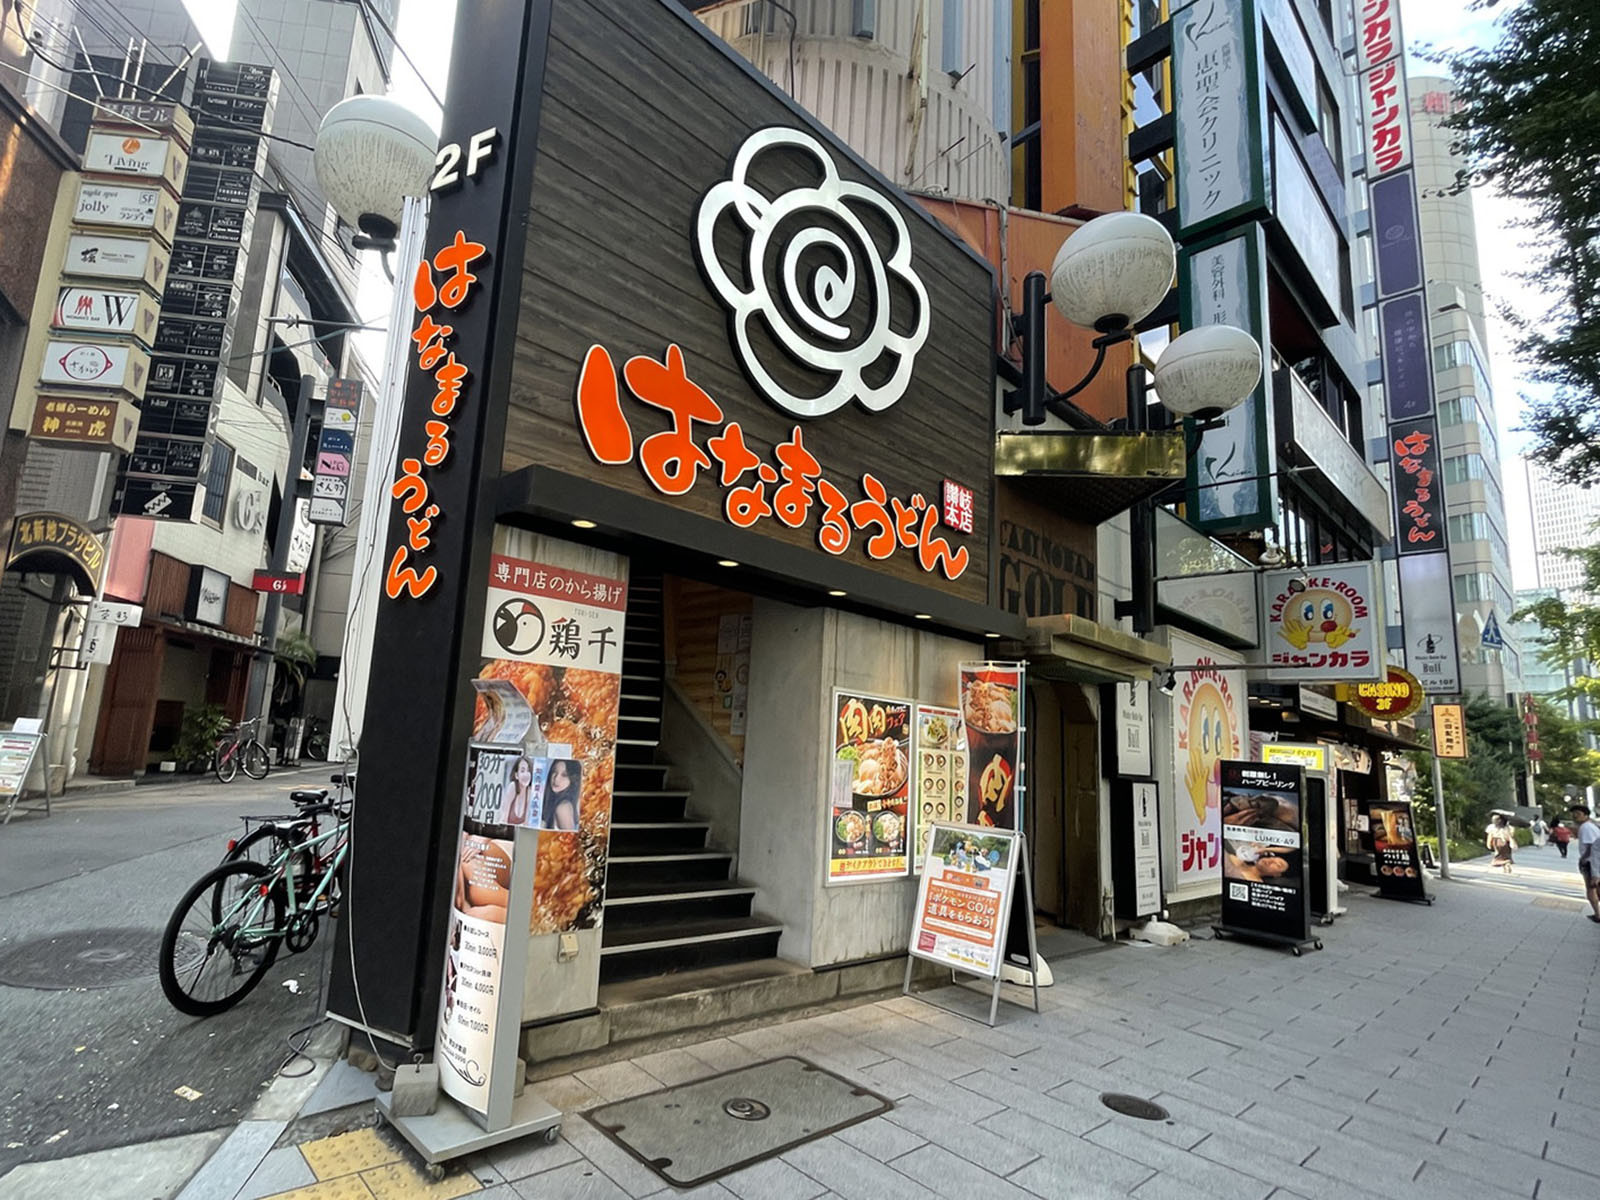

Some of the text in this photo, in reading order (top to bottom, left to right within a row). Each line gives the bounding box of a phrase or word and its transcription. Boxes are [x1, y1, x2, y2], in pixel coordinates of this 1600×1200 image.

[1362, 0, 1393, 65] ンカラ
[1369, 61, 1403, 173] ジャンカラ
[429, 126, 497, 192] 2F
[79, 200, 109, 214] jolly
[102, 294, 136, 326] W
[384, 229, 487, 600] はなまるうどん
[576, 343, 970, 581] はなまるうどん
[1393, 431, 1436, 543] はなまるうどん
[494, 562, 623, 605] 専門店のから揚げ
[548, 617, 617, 664] 鶏千
[1272, 650, 1370, 668] ジャンカラ
[1358, 682, 1410, 698] CASINO
